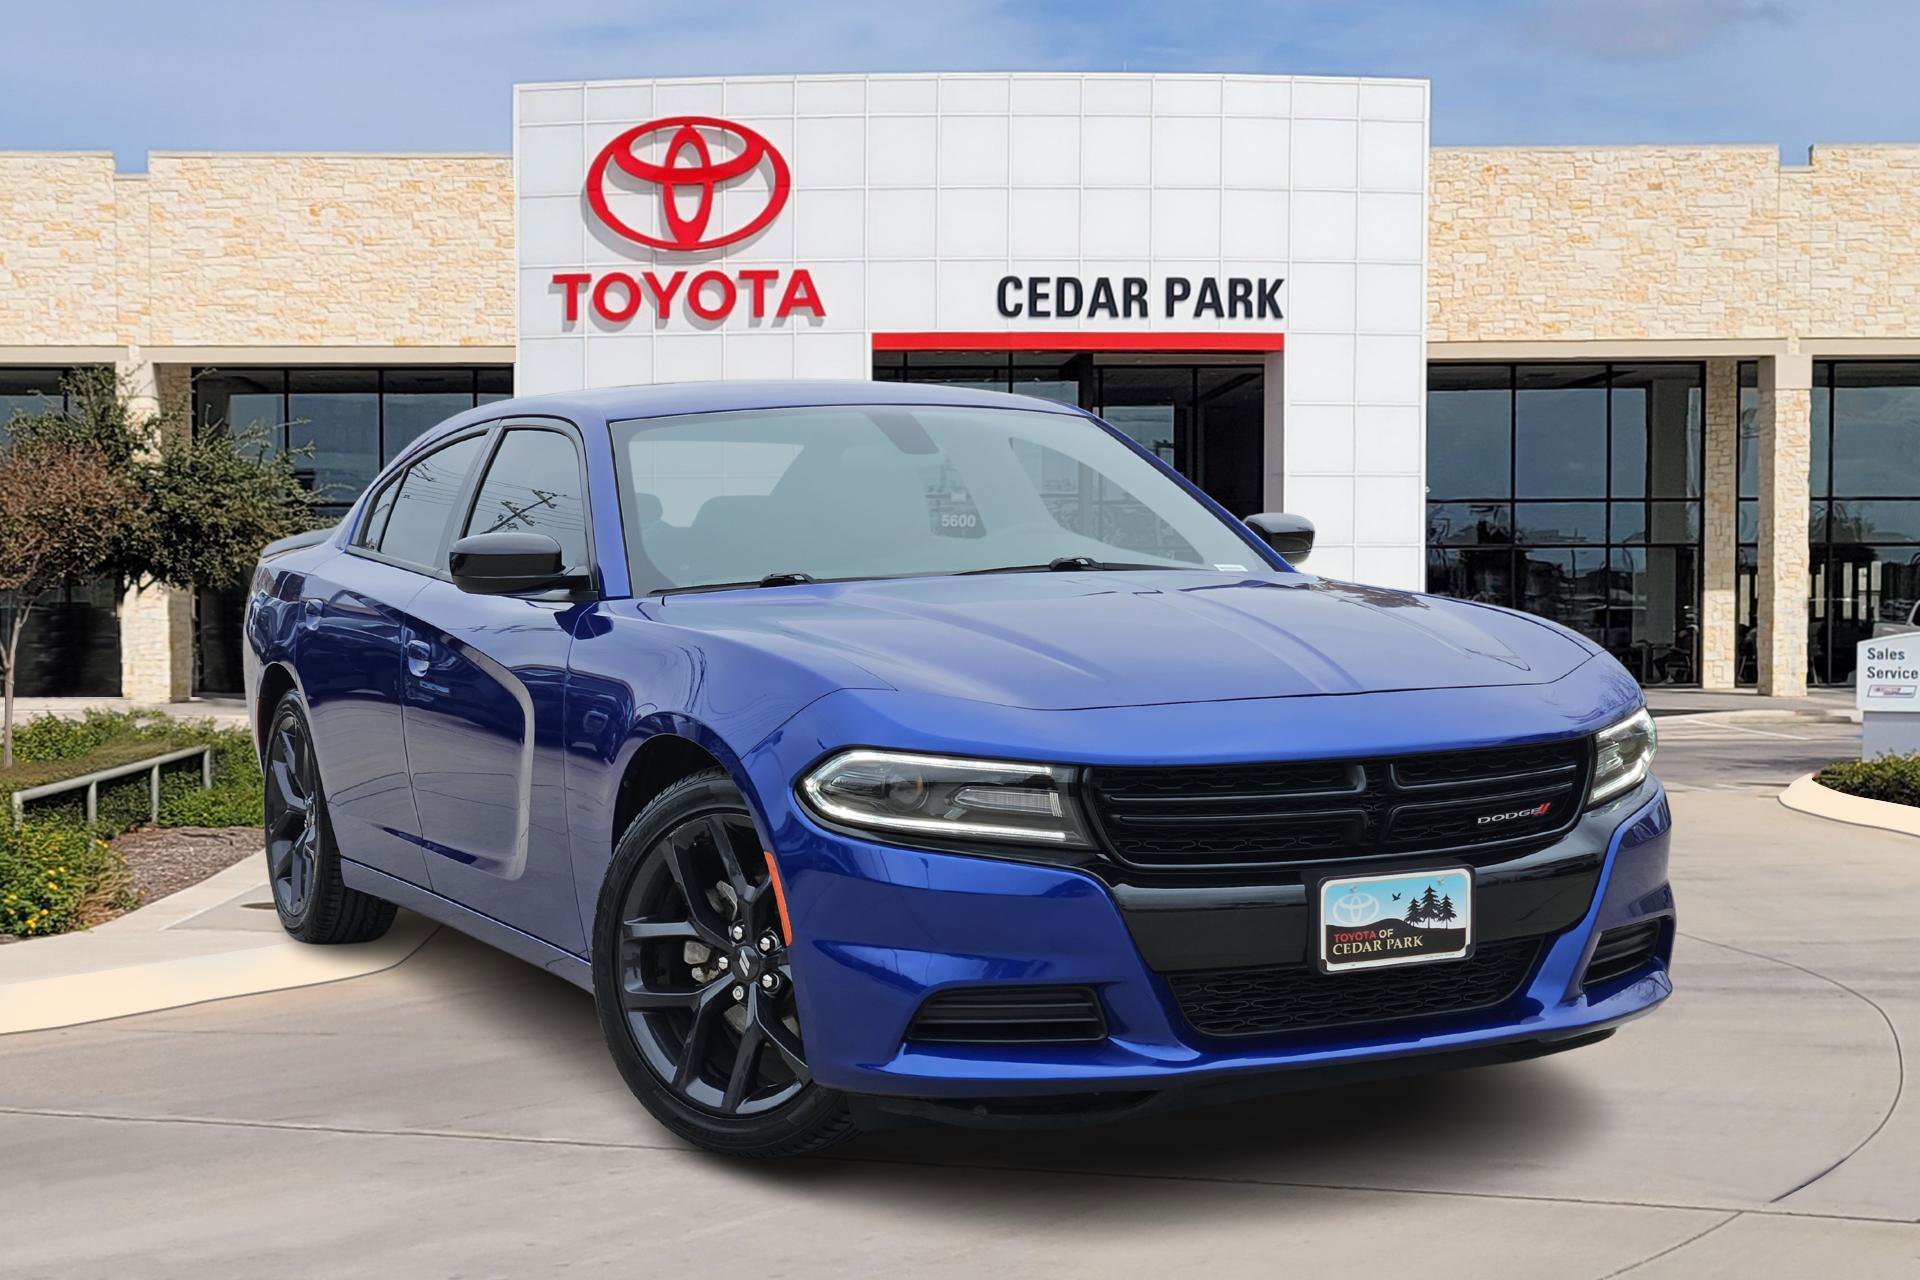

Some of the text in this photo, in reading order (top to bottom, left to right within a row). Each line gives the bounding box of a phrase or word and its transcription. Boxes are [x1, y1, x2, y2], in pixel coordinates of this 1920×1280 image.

[552, 269, 827, 323] TOYOTA
[997, 275, 1285, 320] CEDAR PARK
[941, 514, 976, 528] 5600
[1867, 647, 1905, 660] Sales
[1866, 665, 1919, 680] Service
[1477, 807, 1541, 824] DODGE
[1333, 928, 1394, 943] TOYOTA OF
[1332, 935, 1424, 956] CEDAR PARK
